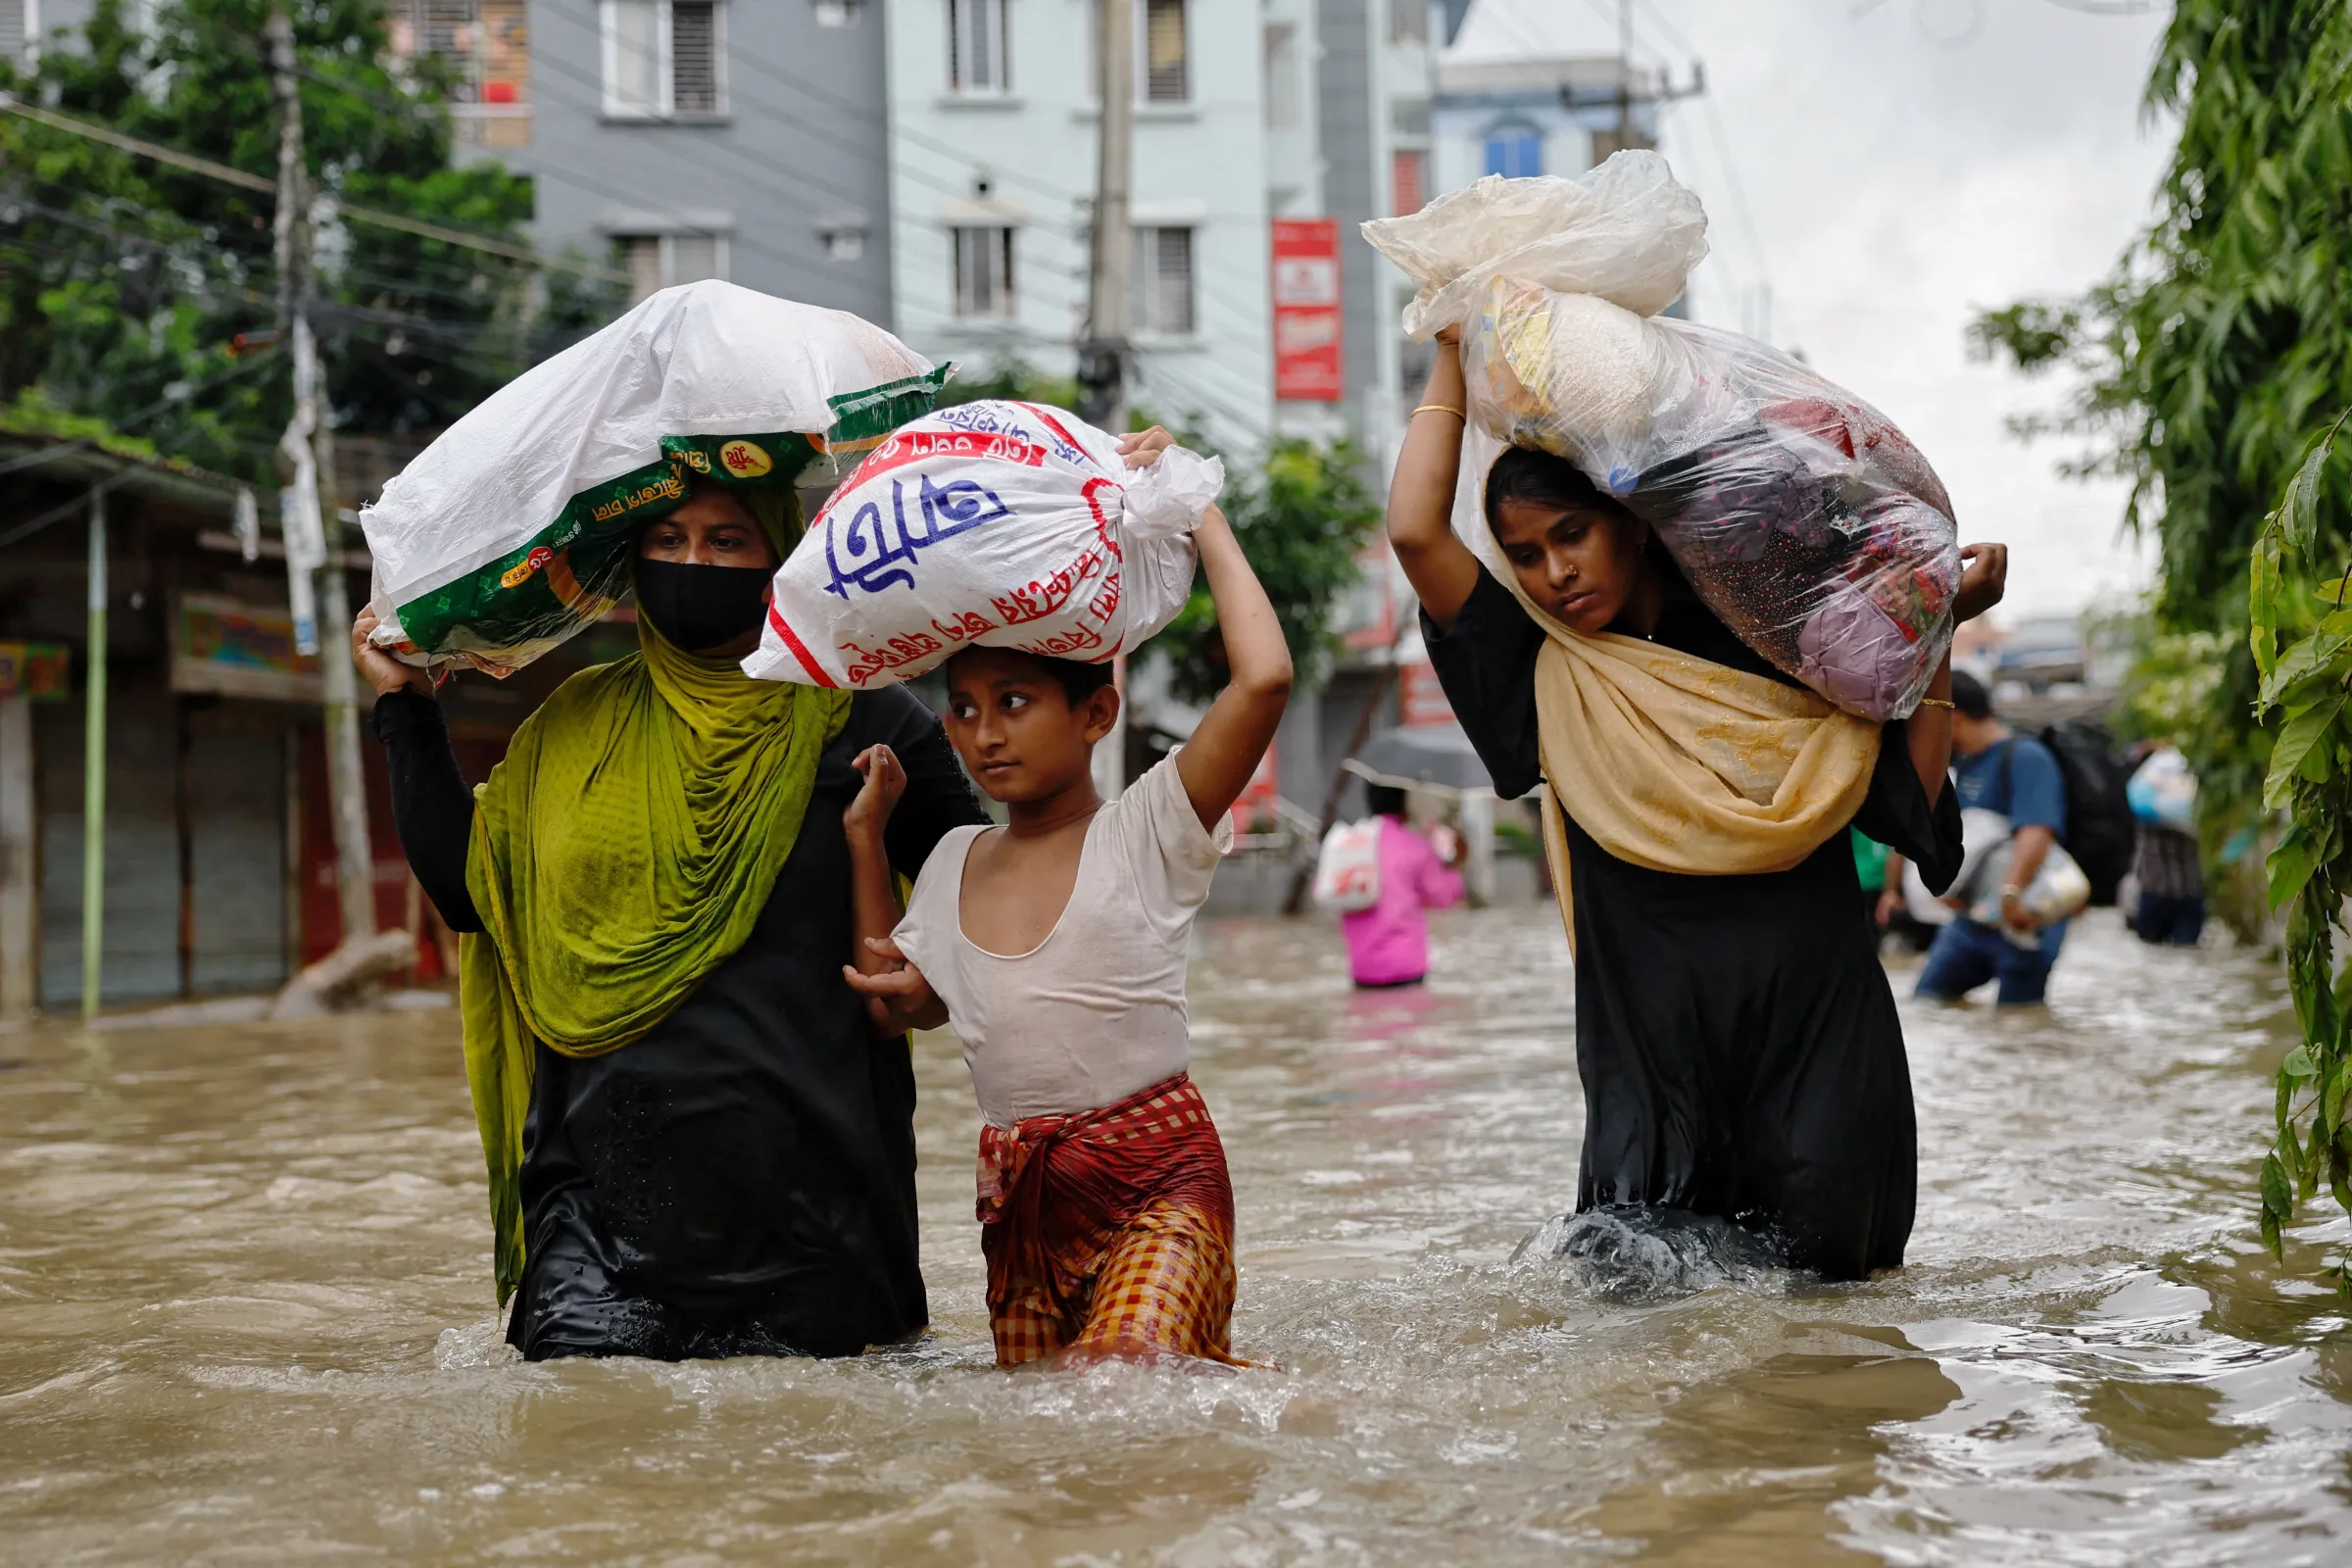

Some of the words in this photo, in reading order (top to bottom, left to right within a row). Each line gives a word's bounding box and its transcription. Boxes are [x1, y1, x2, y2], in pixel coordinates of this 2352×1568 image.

[591, 498, 626, 522] চাল
[823, 472, 1018, 601] আটা
[529, 550, 552, 570] ২৫
[931, 611, 1002, 642] জন্য
